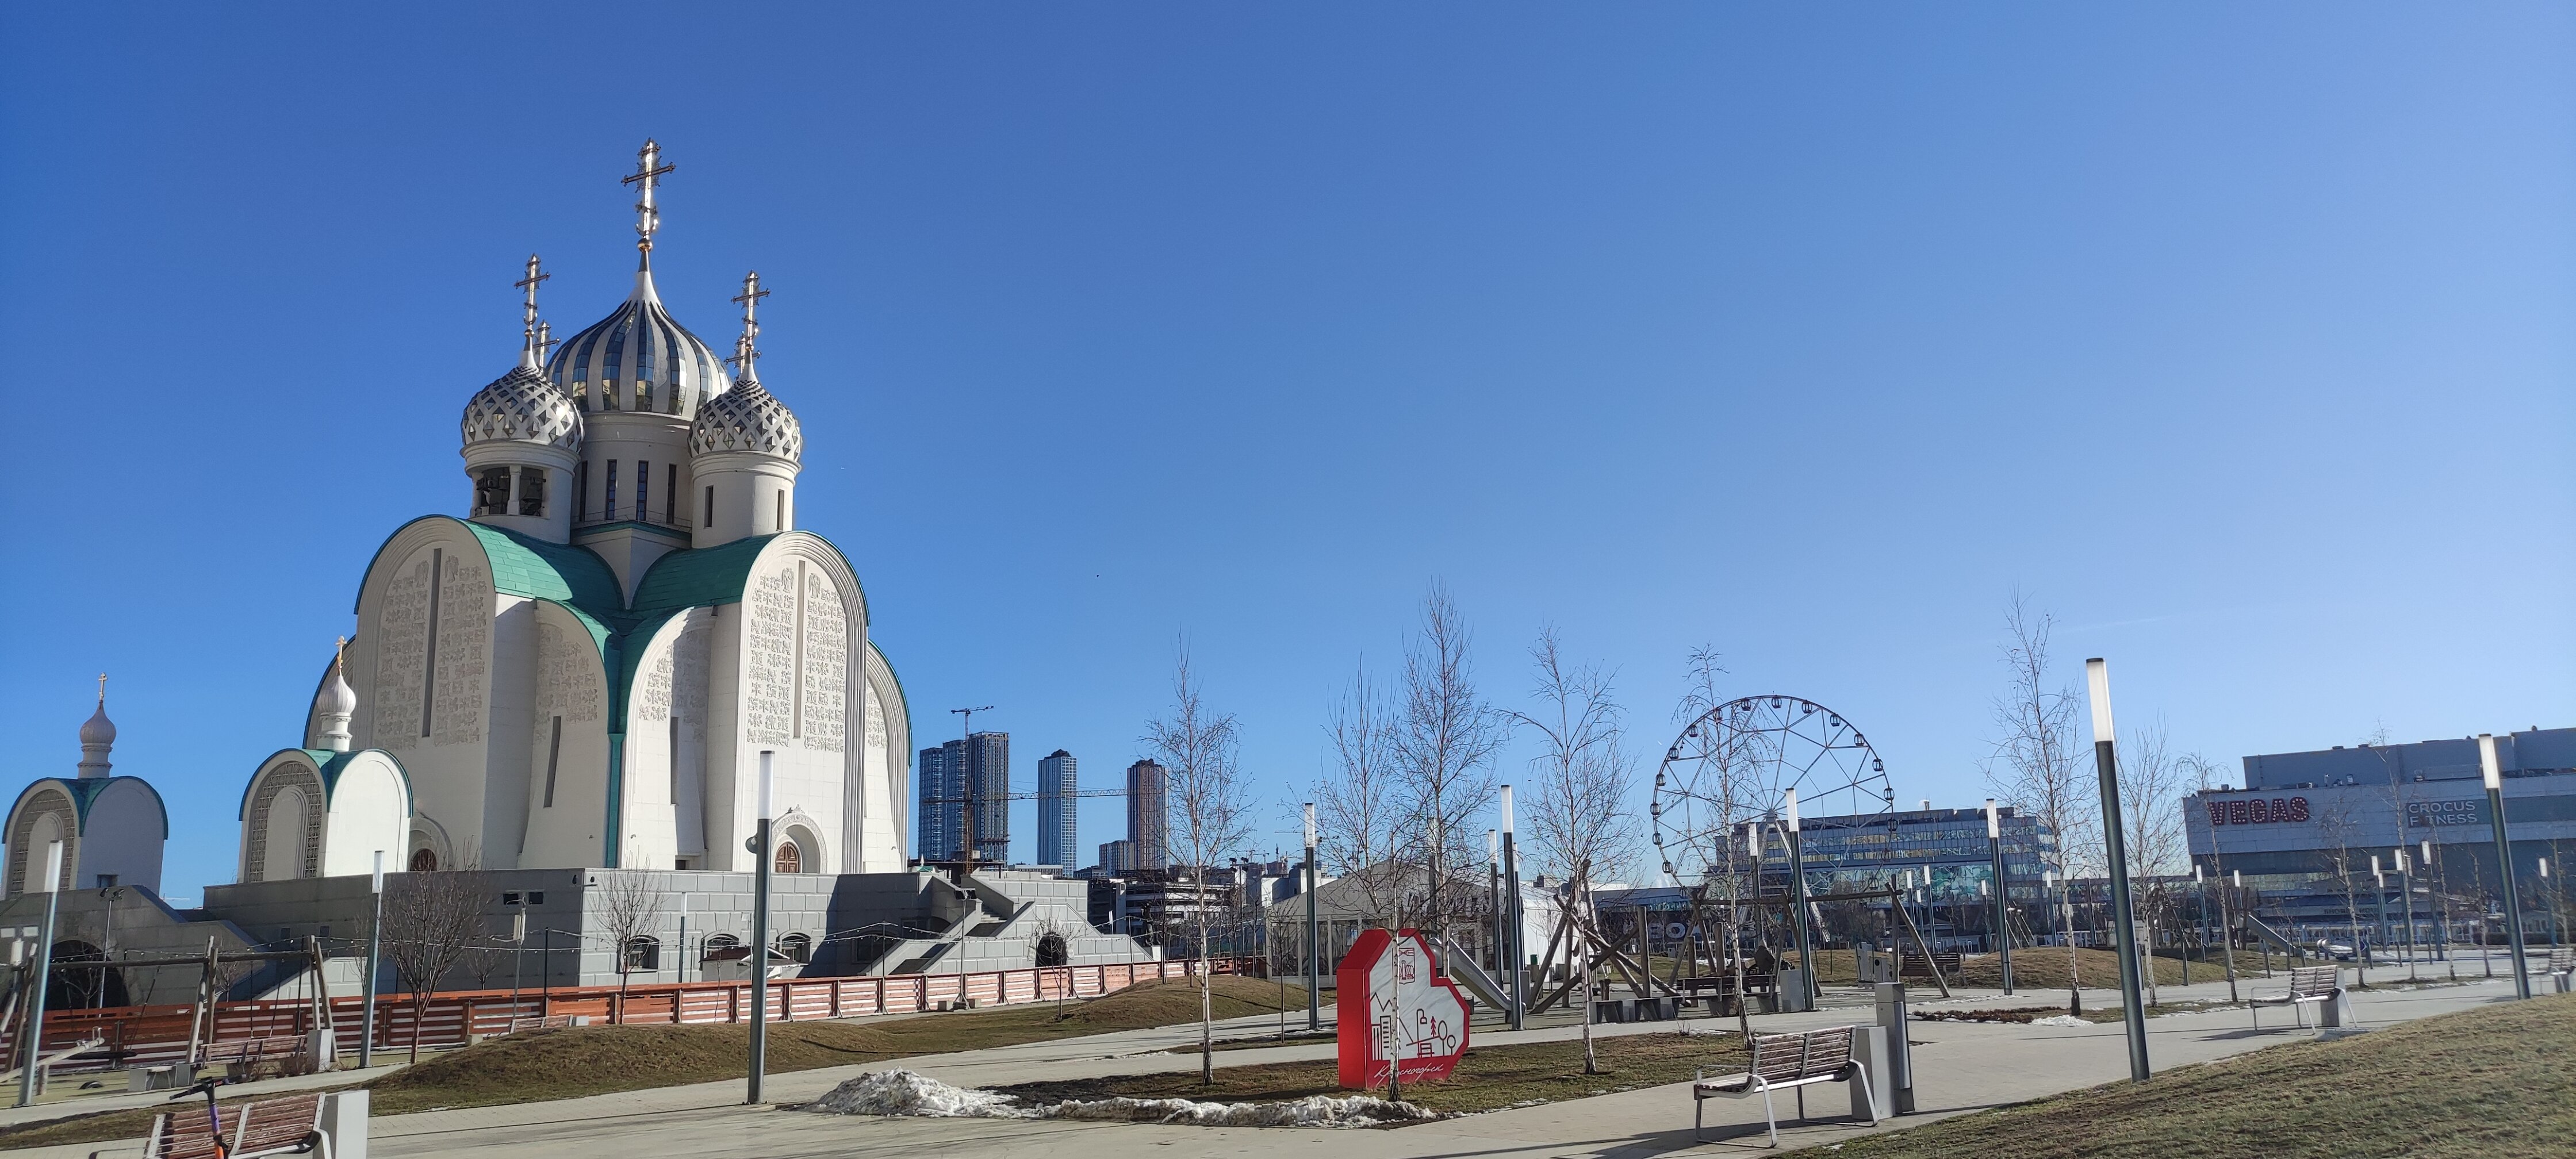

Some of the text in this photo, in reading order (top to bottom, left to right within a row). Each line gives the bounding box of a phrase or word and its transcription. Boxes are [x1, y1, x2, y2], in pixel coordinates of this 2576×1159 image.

[2207, 797, 2309, 825] VEGAS
[2409, 801, 2475, 813] CROCUS
[2409, 813, 2477, 826] FTNESS
[1374, 1062, 1444, 1088] Крсногорск
